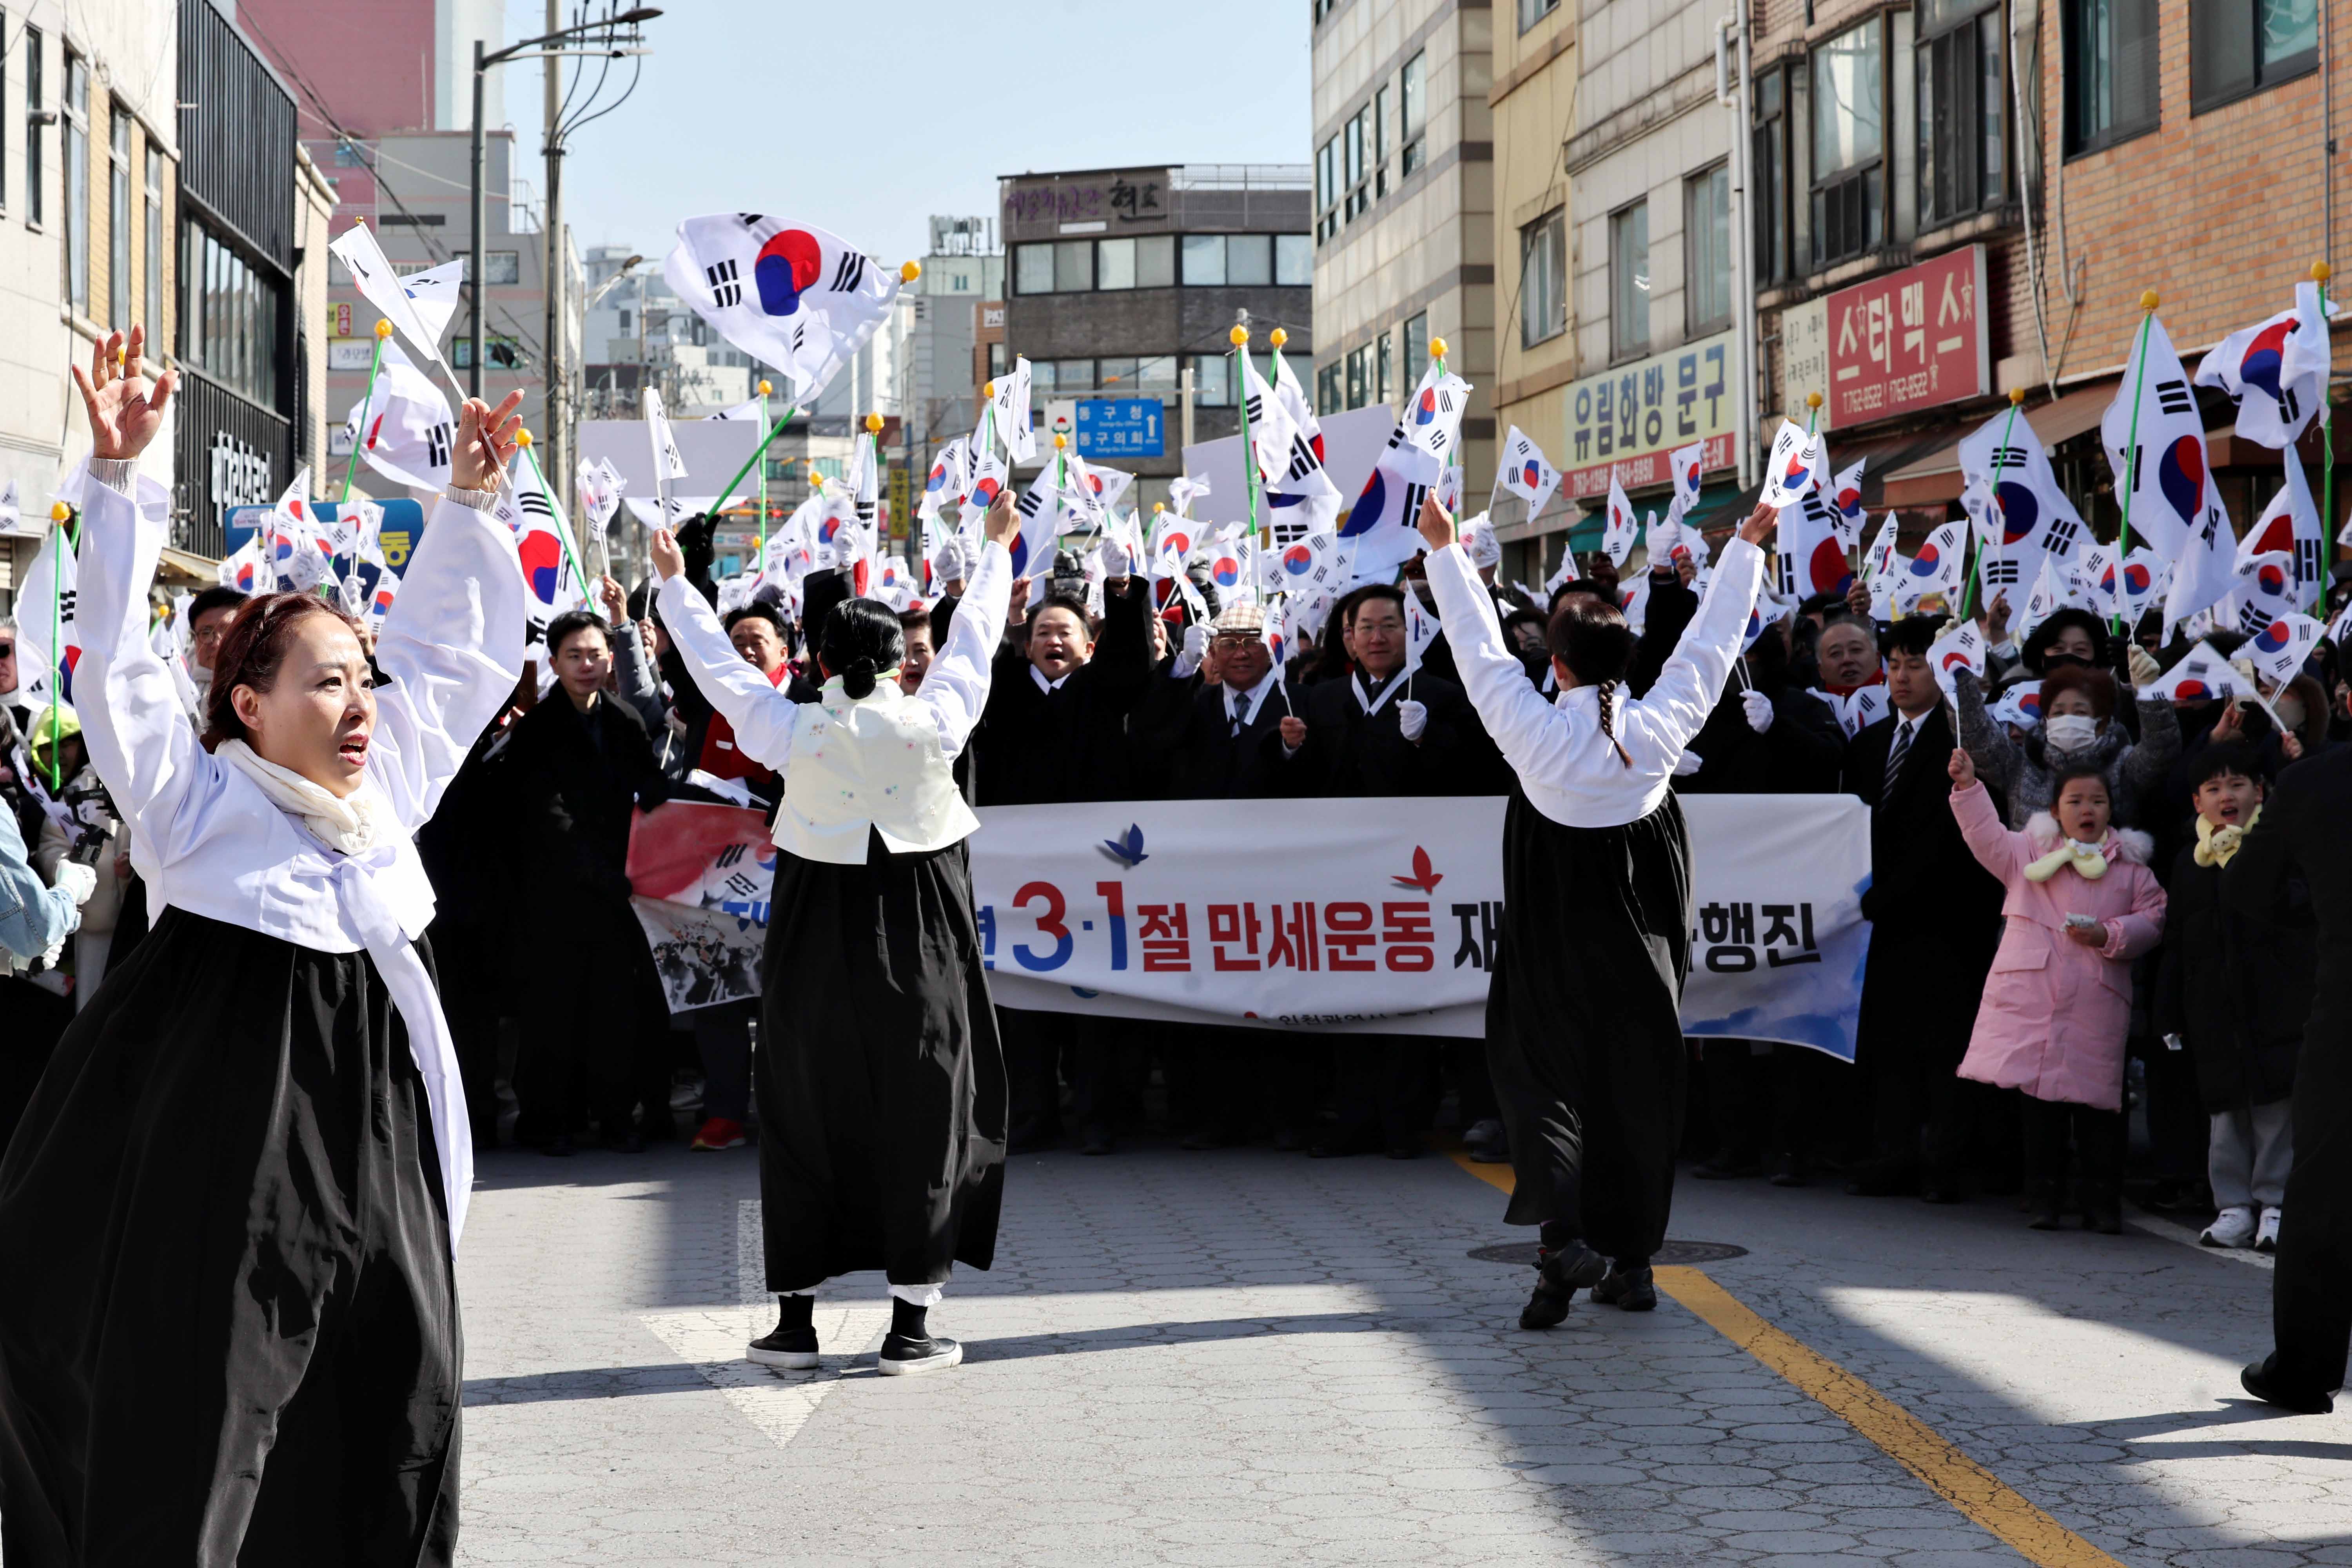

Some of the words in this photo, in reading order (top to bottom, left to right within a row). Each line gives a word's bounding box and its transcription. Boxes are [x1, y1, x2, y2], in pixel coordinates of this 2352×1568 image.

[1837, 271, 1963, 382] 스타맥스
[1079, 431, 1143, 446] 동구의회
[1575, 363, 1664, 462] 유림화방
[1677, 342, 1724, 437] 문구
[1207, 902, 1435, 972] 만세운동
[1688, 902, 1822, 973] 행진
